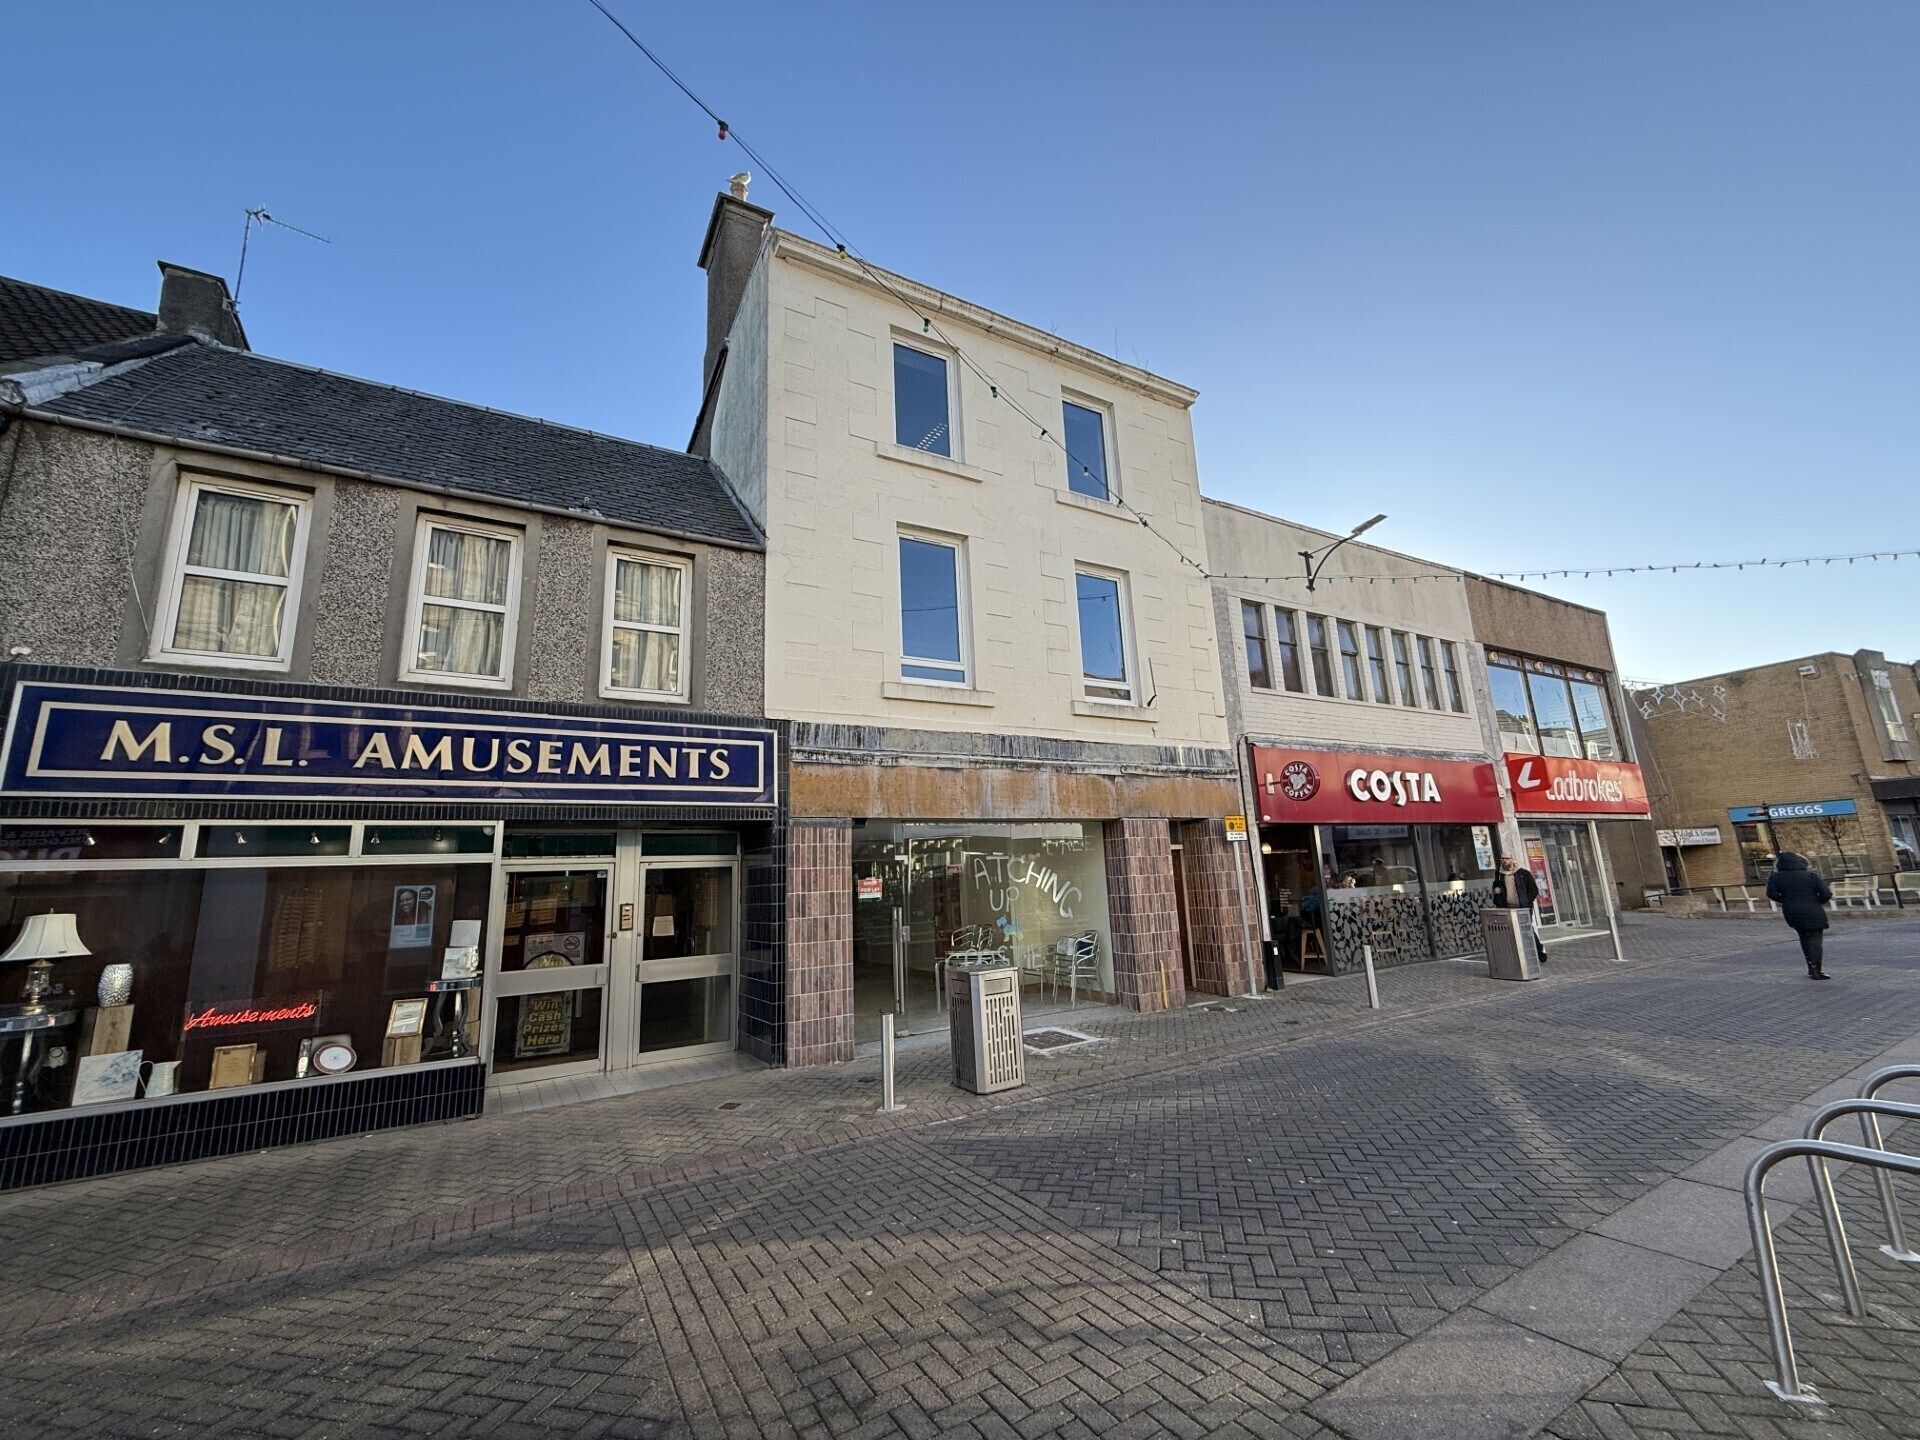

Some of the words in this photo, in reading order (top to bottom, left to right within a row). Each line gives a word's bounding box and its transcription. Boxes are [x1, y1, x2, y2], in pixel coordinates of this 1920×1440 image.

[99, 719, 309, 767] M.S.L.
[352, 732, 731, 781] AMUSEMENTS
[1284, 764, 1308, 776] COSTA
[1284, 783, 1312, 798] COFFEE
[1347, 768, 1442, 807] COSTA
[1768, 804, 1824, 817] GREGGS
[990, 886, 1020, 912] UP
[533, 999, 559, 1012] Win
[184, 1002, 317, 1031] Amusements
[528, 1010, 562, 1023] Cash
[523, 1022, 566, 1035] Prizes
